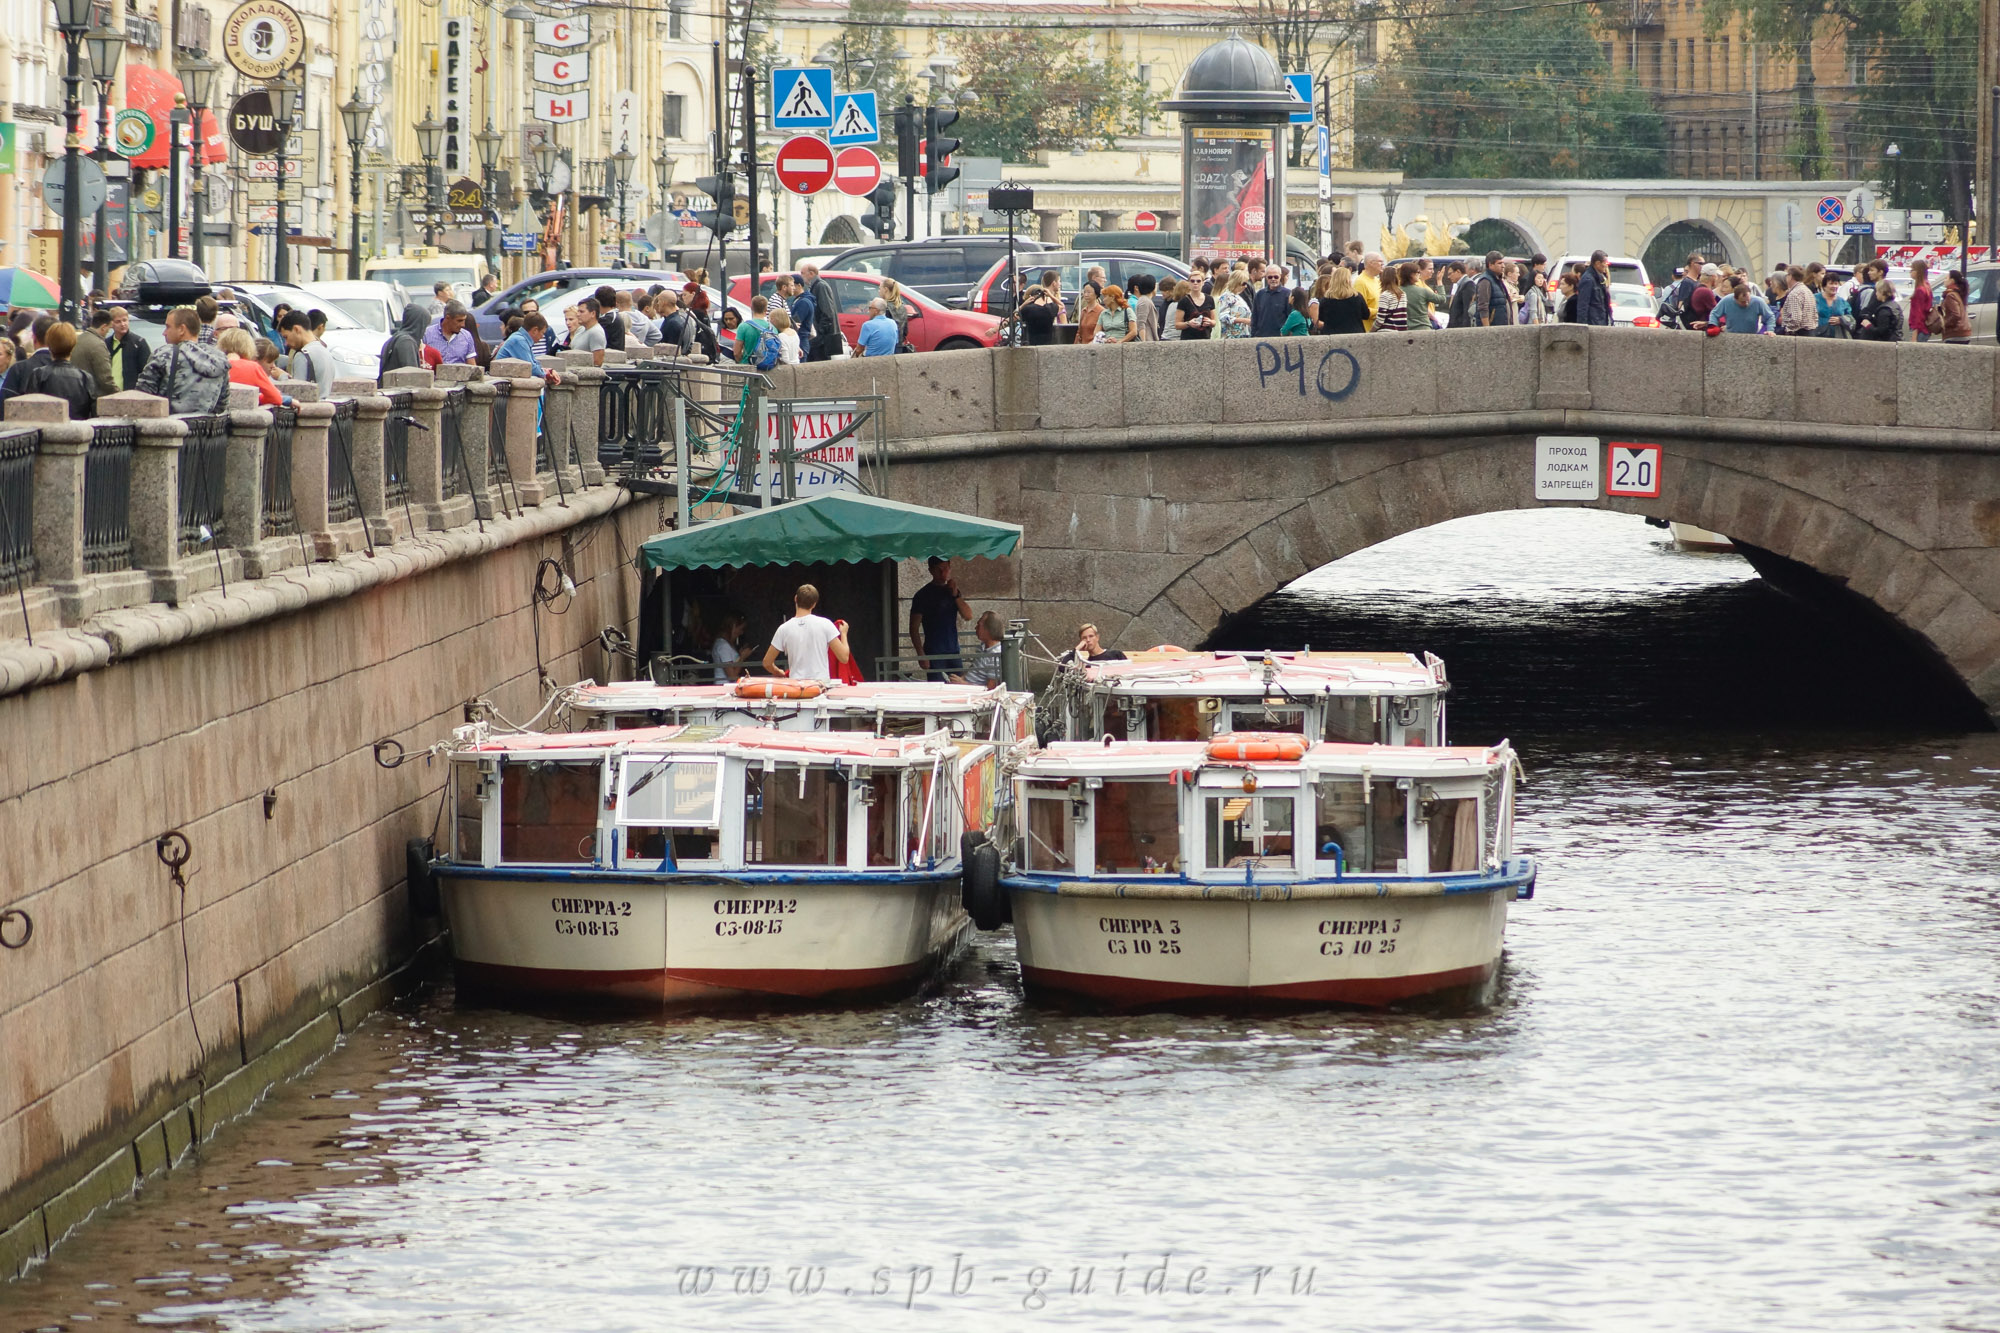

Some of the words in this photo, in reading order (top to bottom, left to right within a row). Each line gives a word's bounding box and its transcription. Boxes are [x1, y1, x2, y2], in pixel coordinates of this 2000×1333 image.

[228, 4, 298, 47] ШОКОЛАДНИЦА
[447, 21, 460, 93] CAFE
[550, 0, 574, 117] ССЫ
[235, 114, 282, 131] БУШ
[446, 116, 459, 170] BAR
[255, 161, 296, 172] ФОО
[1194, 173, 1228, 184] CRAZY
[450, 189, 482, 208] 24
[413, 213, 441, 222] КОЕ
[456, 213, 483, 222] ХАУЗ
[1548, 447, 1588, 456] ПРОХОД
[1547, 463, 1589, 472] ЛОДКАМ
[1615, 460, 1651, 486] 2.0
[1541, 479, 1593, 490] ЗАПРЕЩЁН
[551, 898, 632, 917] СИЕРРА-2
[713, 898, 798, 916] СИЕРРА-2
[1099, 917, 1164, 934] СИЕРРА
[1170, 919, 1181, 935] 3
[1318, 919, 1387, 935] СИЕРРА
[1392, 918, 1402, 933] 3
[1133, 939, 1152, 954] 10
[1158, 939, 1182, 954] 25
[1353, 940, 1372, 954] 10
[1379, 938, 1397, 954] 25
